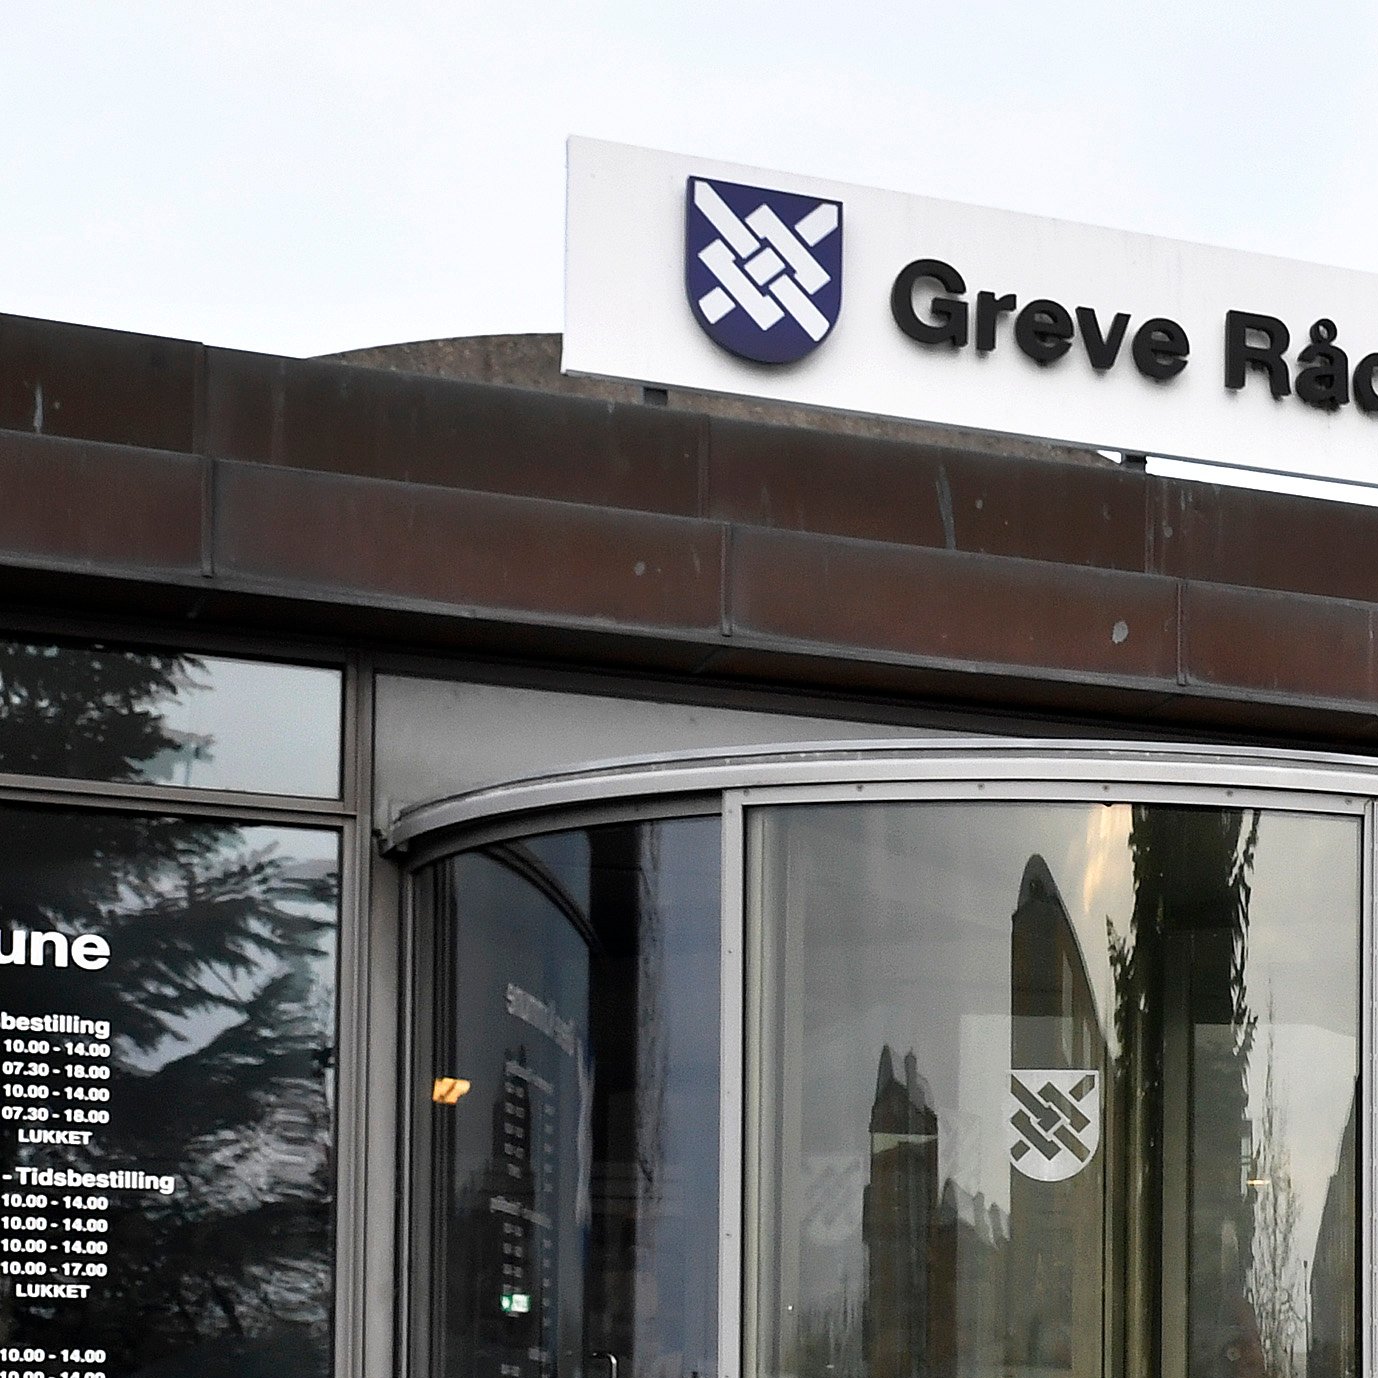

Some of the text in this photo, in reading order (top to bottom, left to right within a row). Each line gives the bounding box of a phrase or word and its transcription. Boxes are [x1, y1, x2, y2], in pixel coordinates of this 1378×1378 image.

[891, 259, 1189, 383] Greve
[1, 1011, 110, 1040] bestilling
[4, 1039, 49, 1054] 10.00
[65, 1042, 110, 1057] 14.00
[3, 1062, 49, 1076] 07.30
[65, 1065, 110, 1079] 18.00
[3, 1084, 49, 1098] 10.00
[65, 1087, 109, 1101] 14.00
[2, 1106, 48, 1121] 07.30
[64, 1109, 109, 1123] 18.00
[19, 1129, 92, 1144] LUKKET
[15, 1167, 175, 1195] Tidsbestilling
[2, 1194, 47, 1208] 10.00
[63, 1196, 108, 1210] 14.00
[1, 1216, 47, 1230] 10.00
[63, 1218, 108, 1232] 14.00
[1, 1239, 46, 1252] 10.00
[63, 1241, 107, 1254] 14.00
[1, 1261, 46, 1275] 10.00
[62, 1263, 107, 1276] 17.00
[16, 1284, 90, 1298] LUKKET
[0, 1349, 45, 1362] 10.00
[61, 1350, 106, 1363] 14.00
